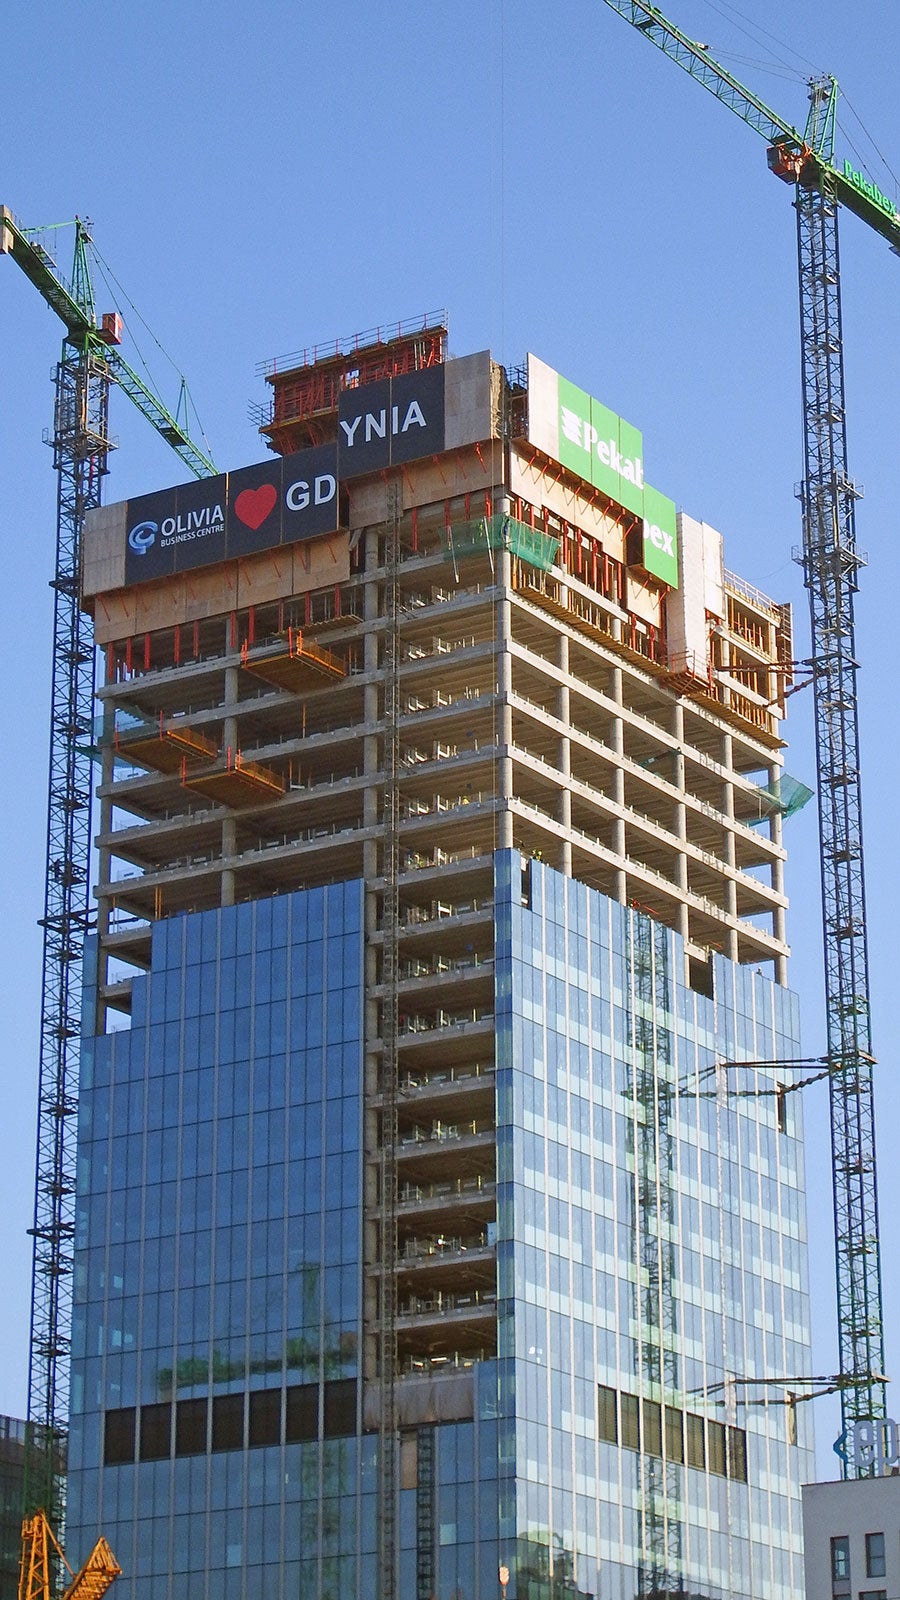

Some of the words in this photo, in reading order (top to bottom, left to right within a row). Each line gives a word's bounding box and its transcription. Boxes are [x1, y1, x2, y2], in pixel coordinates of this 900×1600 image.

[844, 159, 897, 215] Pekabex
[160, 532, 195, 547] BUSINESS
[195, 524, 225, 538] CENTRE
[161, 504, 225, 536] OLIVIA
